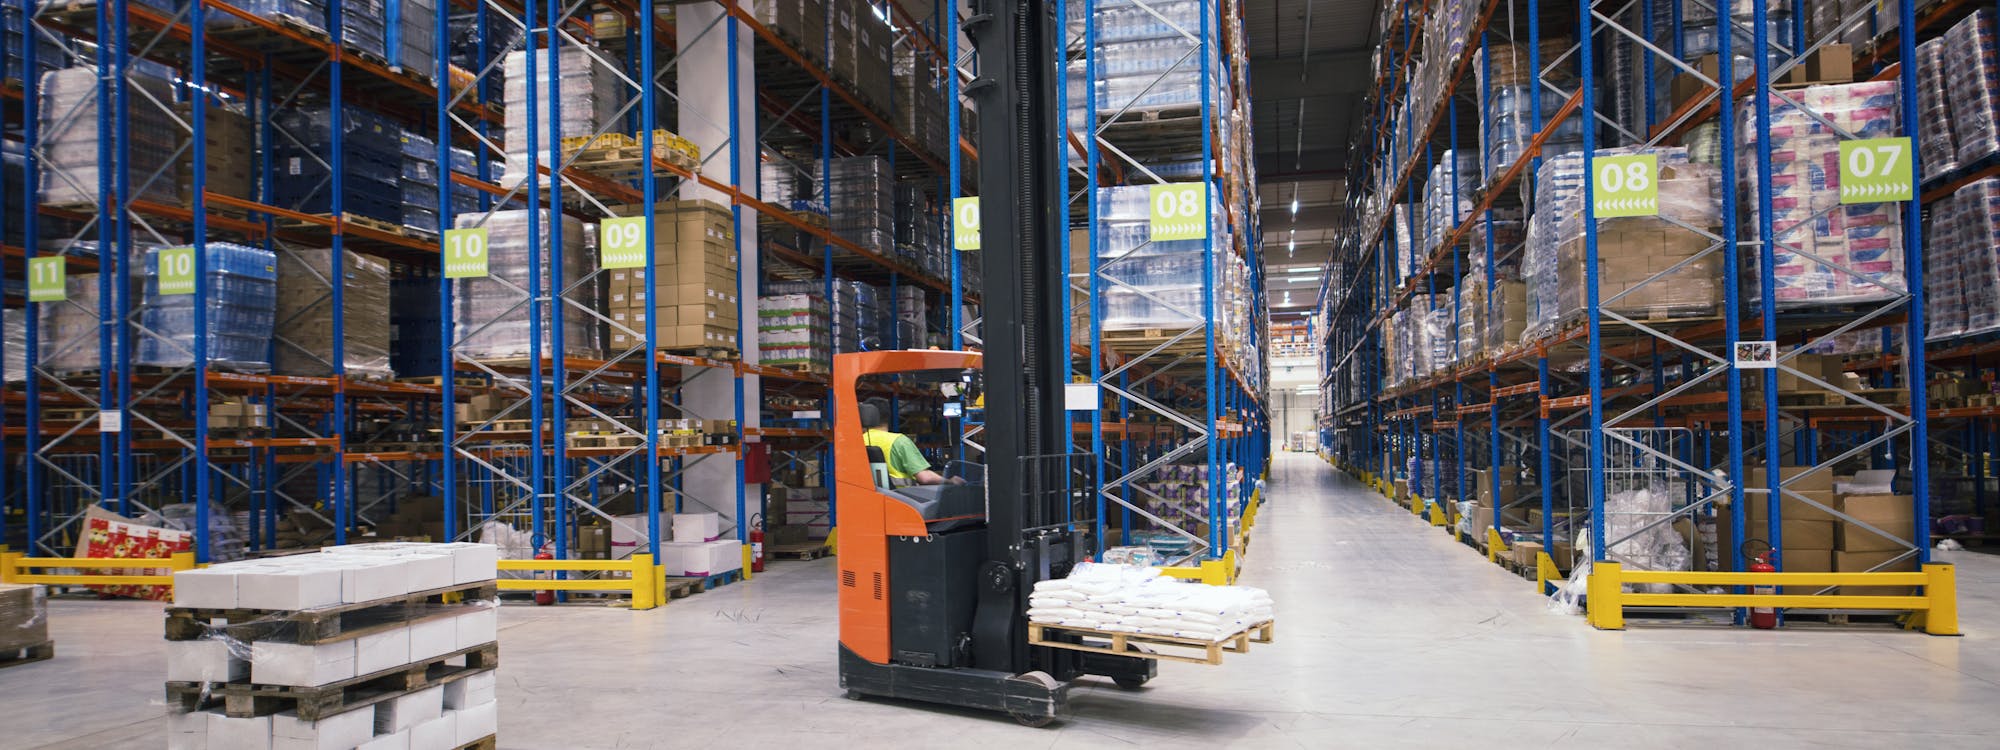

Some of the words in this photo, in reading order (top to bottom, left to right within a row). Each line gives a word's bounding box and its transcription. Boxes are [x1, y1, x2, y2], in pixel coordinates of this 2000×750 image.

[1848, 145, 1902, 177] 07
[1600, 161, 1649, 192] 08
[959, 203, 979, 229] 0
[1156, 190, 1199, 219] 08
[450, 234, 483, 258] 10
[606, 223, 641, 248] 09
[33, 262, 58, 284] 11
[163, 254, 192, 276] 10
